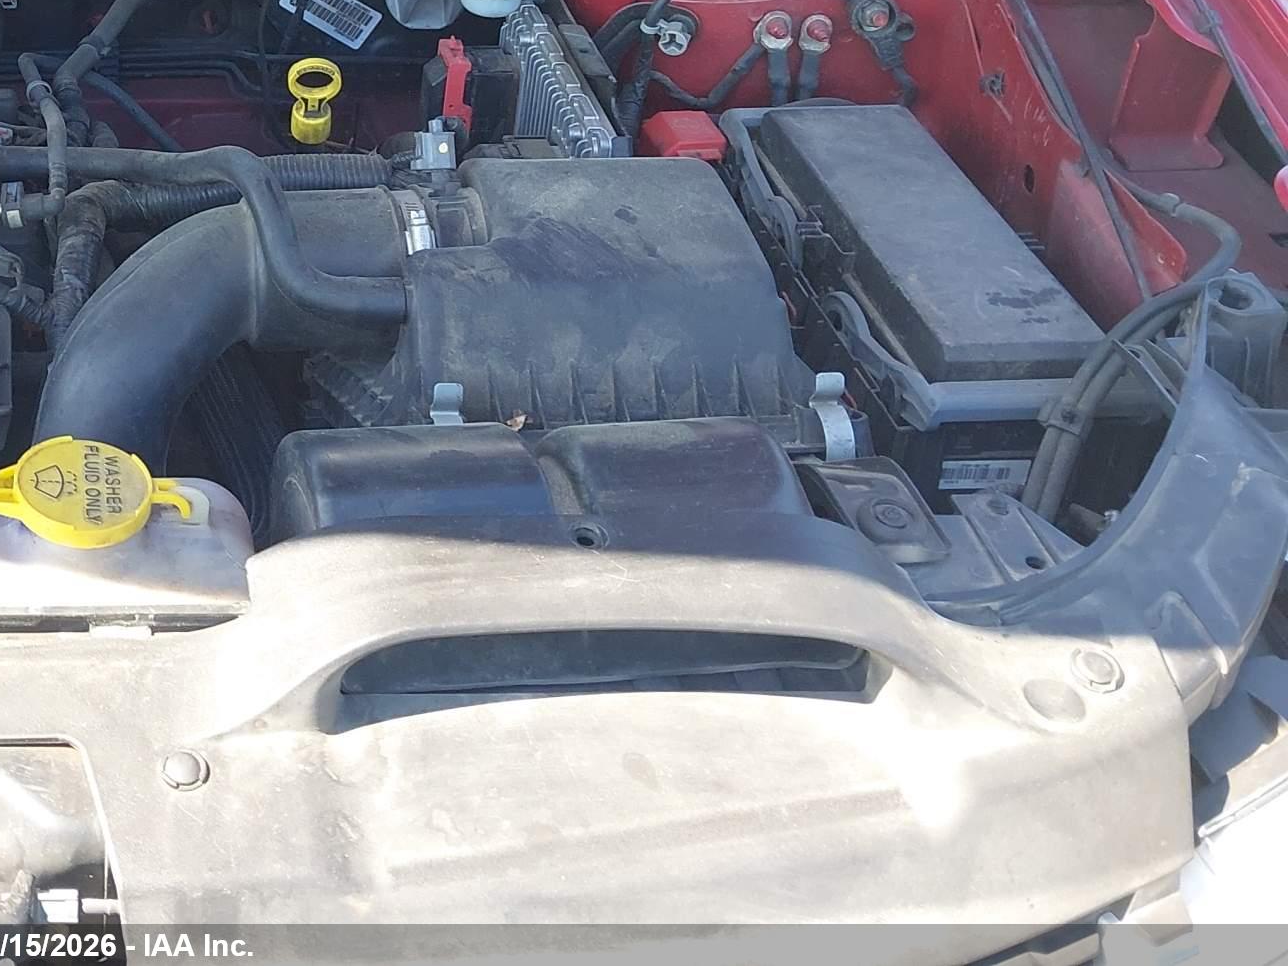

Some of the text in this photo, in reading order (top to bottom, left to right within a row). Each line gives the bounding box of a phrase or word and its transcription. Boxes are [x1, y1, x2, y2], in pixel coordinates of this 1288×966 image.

[84, 445, 103, 525] FLUID ONLY
[104, 455, 122, 514] WASHER
